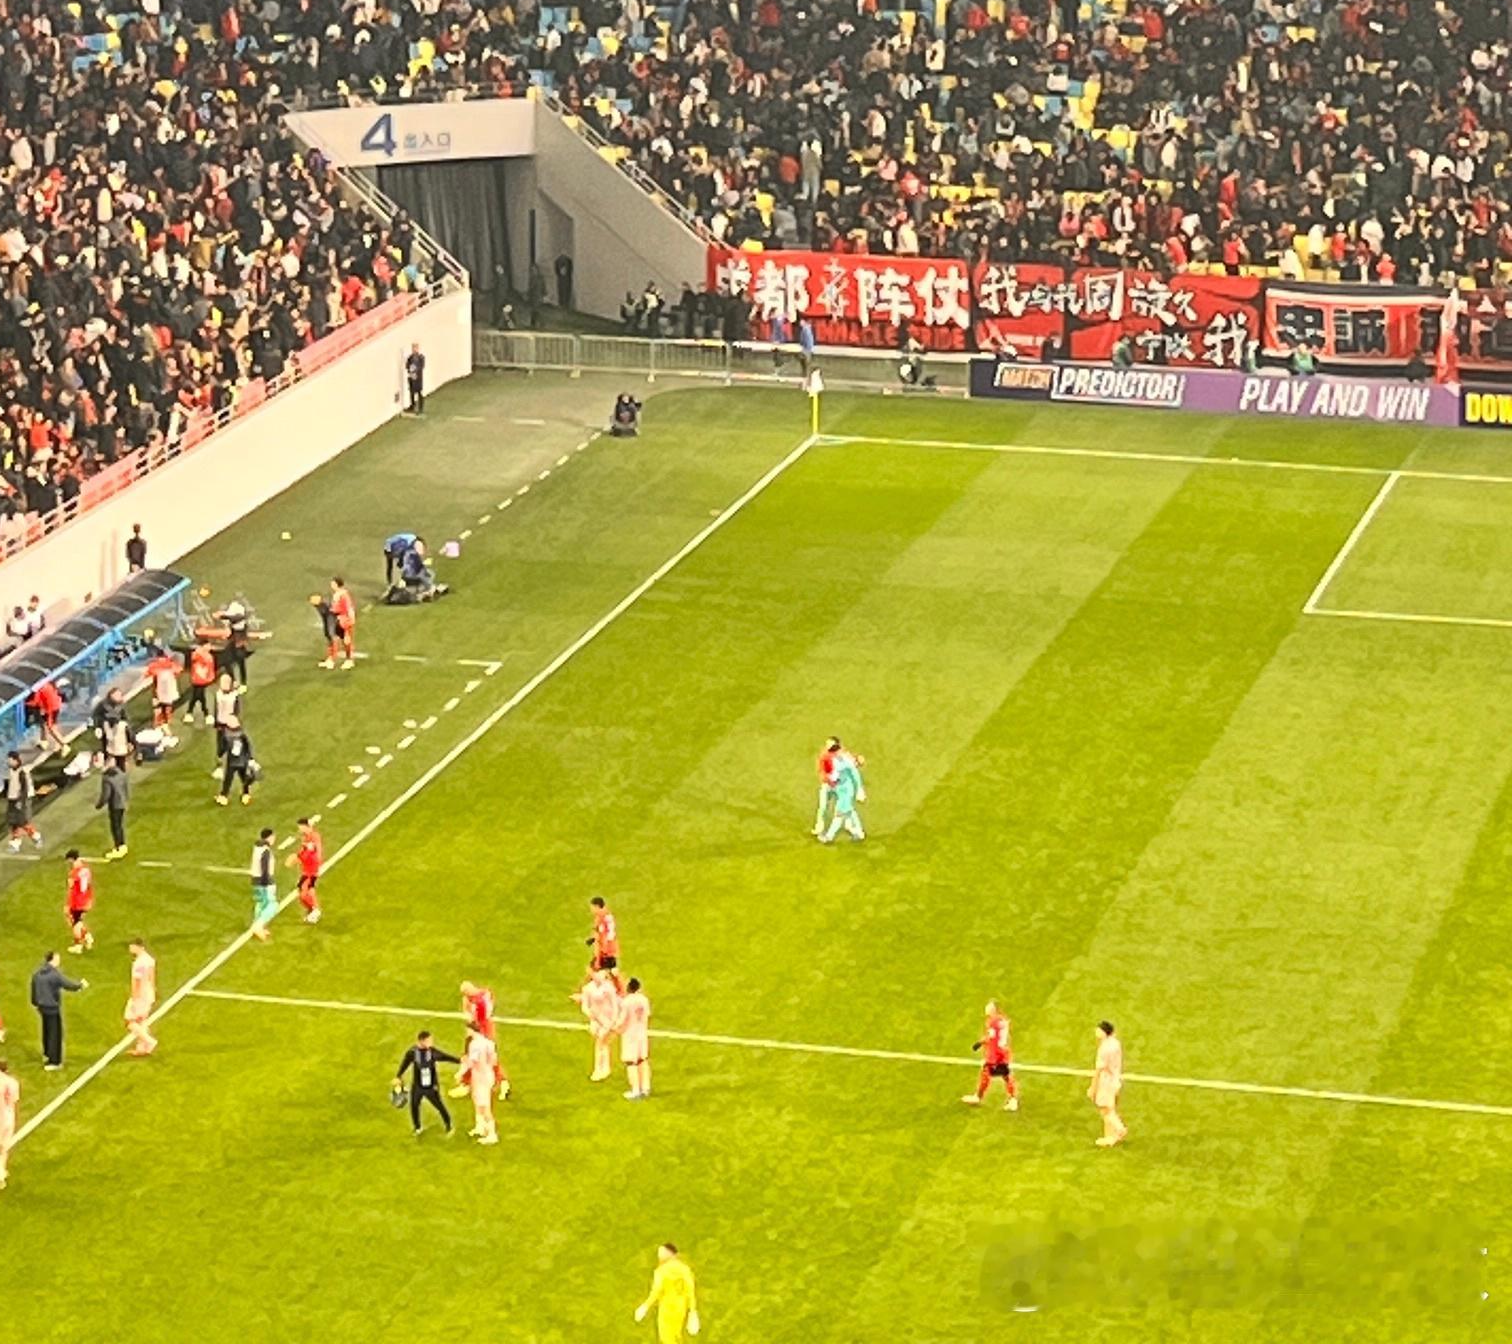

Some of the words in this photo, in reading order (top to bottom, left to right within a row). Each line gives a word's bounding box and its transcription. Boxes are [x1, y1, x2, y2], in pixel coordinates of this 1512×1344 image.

[360, 112, 397, 157] 4
[1059, 368, 1176, 401] PREDICTOR
[1240, 377, 1309, 414] PLAY
[1310, 382, 1369, 417] AND
[1376, 385, 1431, 421] WIN
